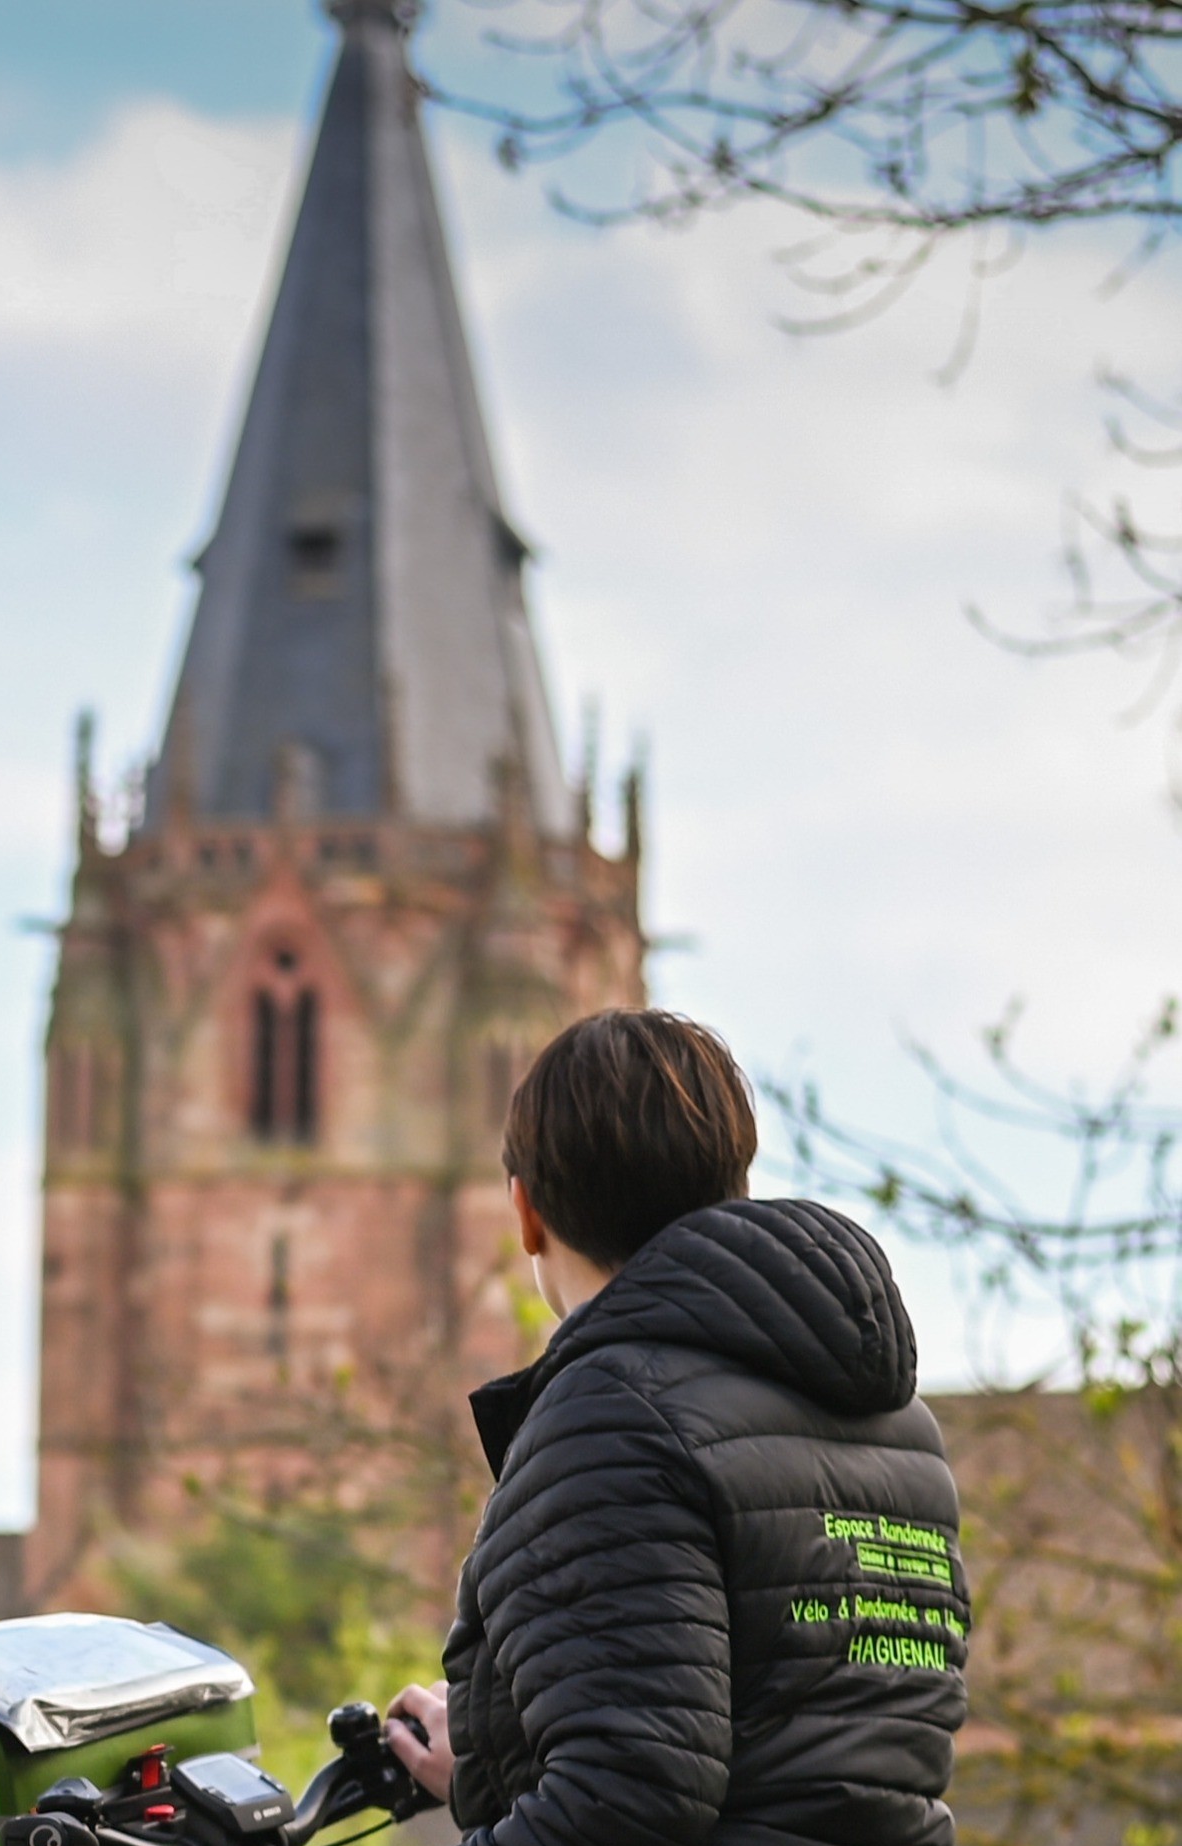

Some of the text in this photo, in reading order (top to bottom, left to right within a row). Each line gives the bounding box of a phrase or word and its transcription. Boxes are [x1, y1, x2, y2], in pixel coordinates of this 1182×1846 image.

[824, 1513, 947, 1554] Espace Randonnée
[791, 1599, 829, 1623] Vélo
[838, 1596, 850, 1620] &
[855, 1594, 919, 1623] Randonnée
[924, 1608, 942, 1627] en
[848, 1635, 946, 1672] HAGUENAU
